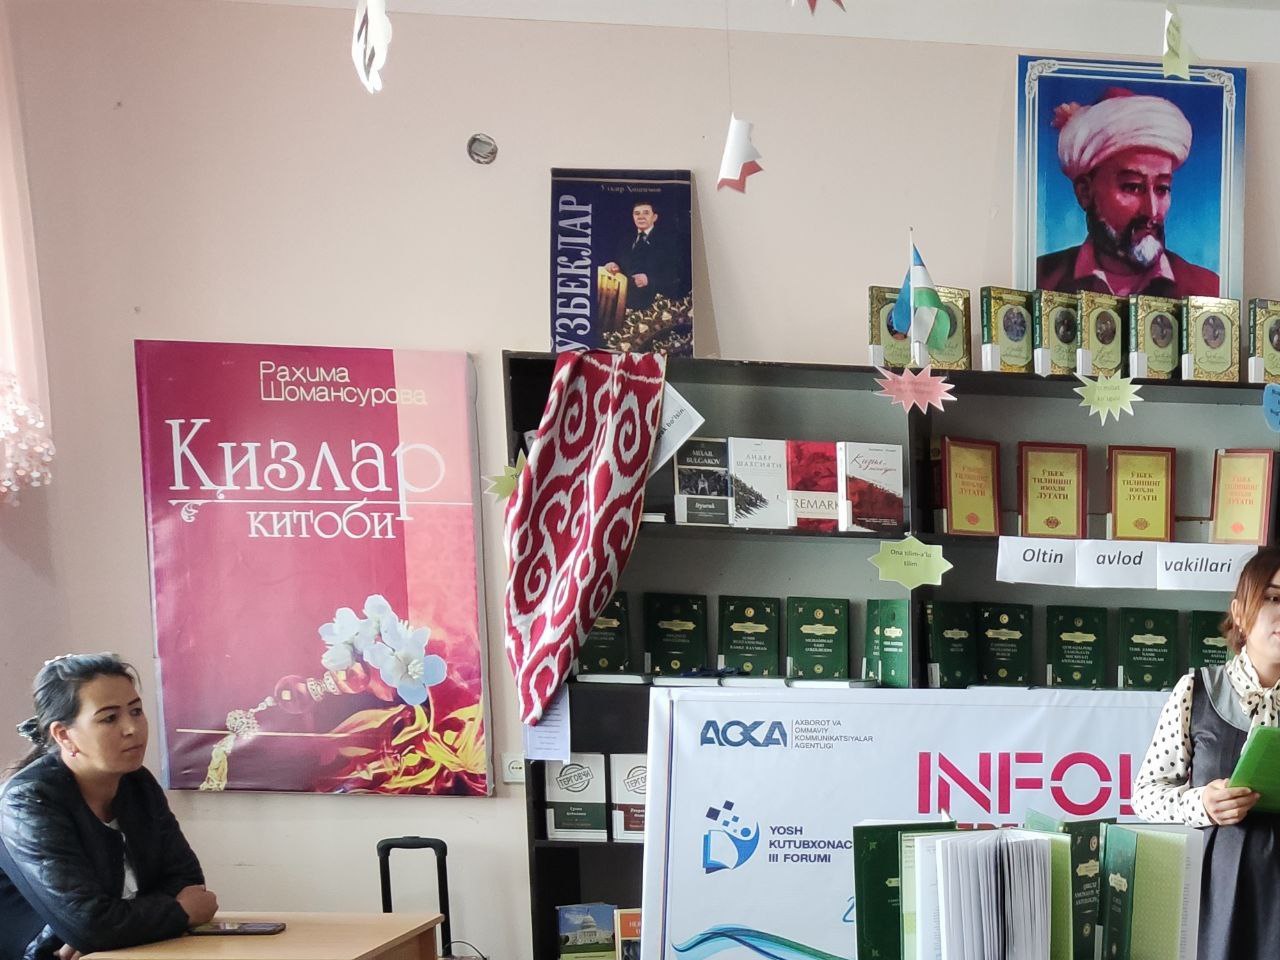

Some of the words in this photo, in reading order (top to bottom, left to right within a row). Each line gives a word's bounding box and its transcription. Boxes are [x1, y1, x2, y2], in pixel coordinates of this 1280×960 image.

[260, 380, 428, 407] Шомансурова
[247, 497, 396, 539] китоби
[1022, 547, 1064, 565] Oltin
[1096, 551, 1143, 566] avlod
[1164, 555, 1232, 573] vakillari
[560, 769, 591, 787] ТЕРГОВЧИ
[769, 825, 803, 836] YOSH
[768, 853, 778, 863] III
[783, 853, 831, 863] FORUMI
